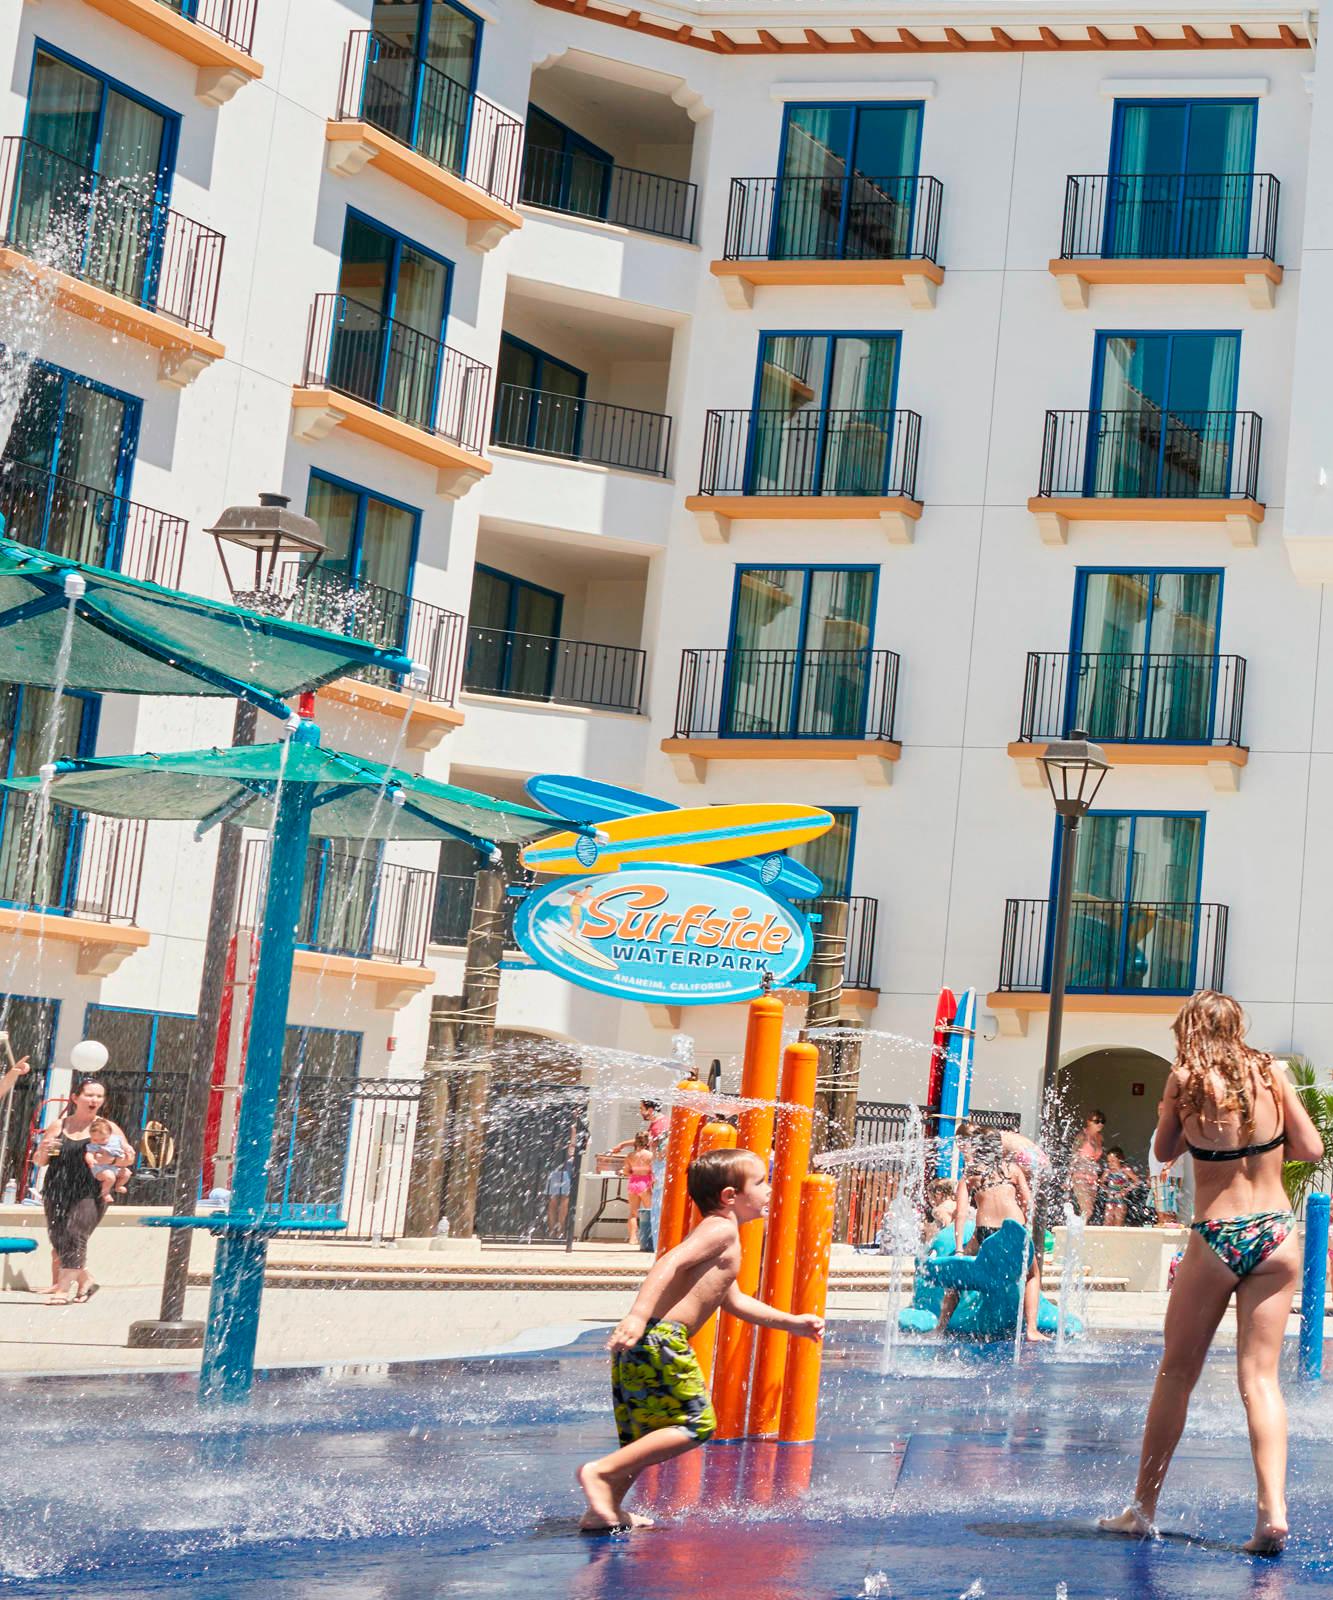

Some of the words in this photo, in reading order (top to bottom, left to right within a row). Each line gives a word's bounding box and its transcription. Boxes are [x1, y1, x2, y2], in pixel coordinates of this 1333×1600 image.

[580, 884, 792, 955] Surfside
[612, 945, 770, 972] WATERPARK
[670, 980, 733, 991] CALIFORNIA
